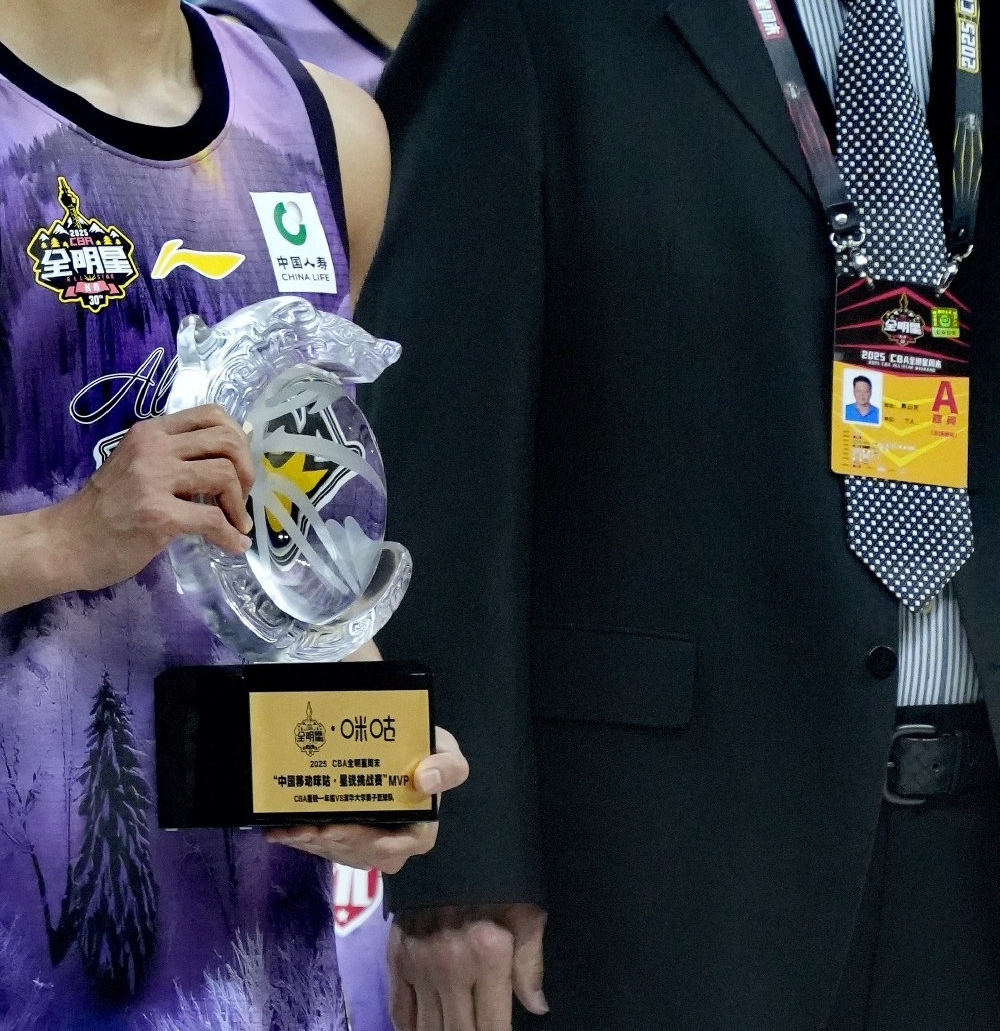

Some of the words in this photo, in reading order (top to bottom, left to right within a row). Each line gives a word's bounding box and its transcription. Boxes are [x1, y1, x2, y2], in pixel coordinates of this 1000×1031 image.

[960, 22, 976, 69] 2025
[69, 229, 88, 237] 2025
[69, 237, 94, 247] CBA
[41, 246, 134, 281] 全明星
[277, 256, 328, 270] 中国人寿
[281, 273, 310, 281] CHINA
[312, 273, 330, 282] LIFE
[884, 319, 922, 336] 全明星
[861, 350, 886, 362] 2025
[932, 380, 959, 414] A
[297, 731, 324, 742] 全明星
[310, 760, 327, 768] 2025
